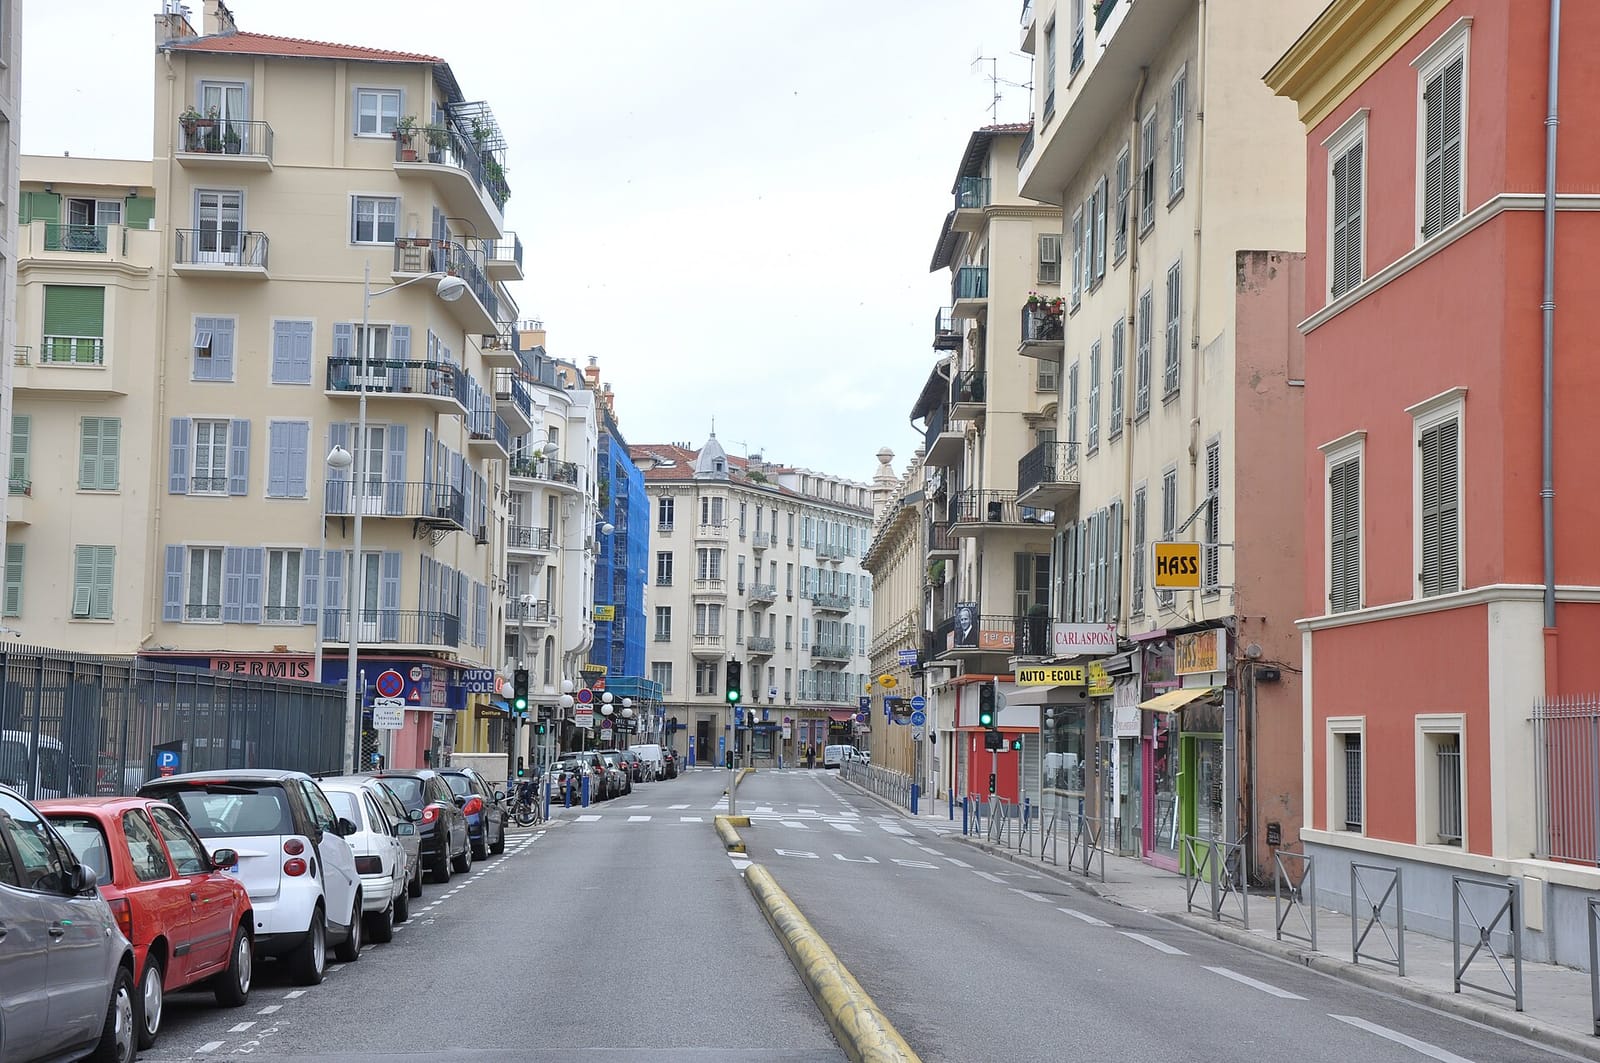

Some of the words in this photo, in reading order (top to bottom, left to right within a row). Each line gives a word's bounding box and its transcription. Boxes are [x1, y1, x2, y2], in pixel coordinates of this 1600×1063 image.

[1157, 556, 1198, 576] HASS
[1055, 631, 1115, 645] CARLASPOSA
[217, 661, 310, 677] PERMIS
[462, 670, 492, 680] AUTO
[163, 753, 174, 766] P
[774, 848, 940, 869] BUS
